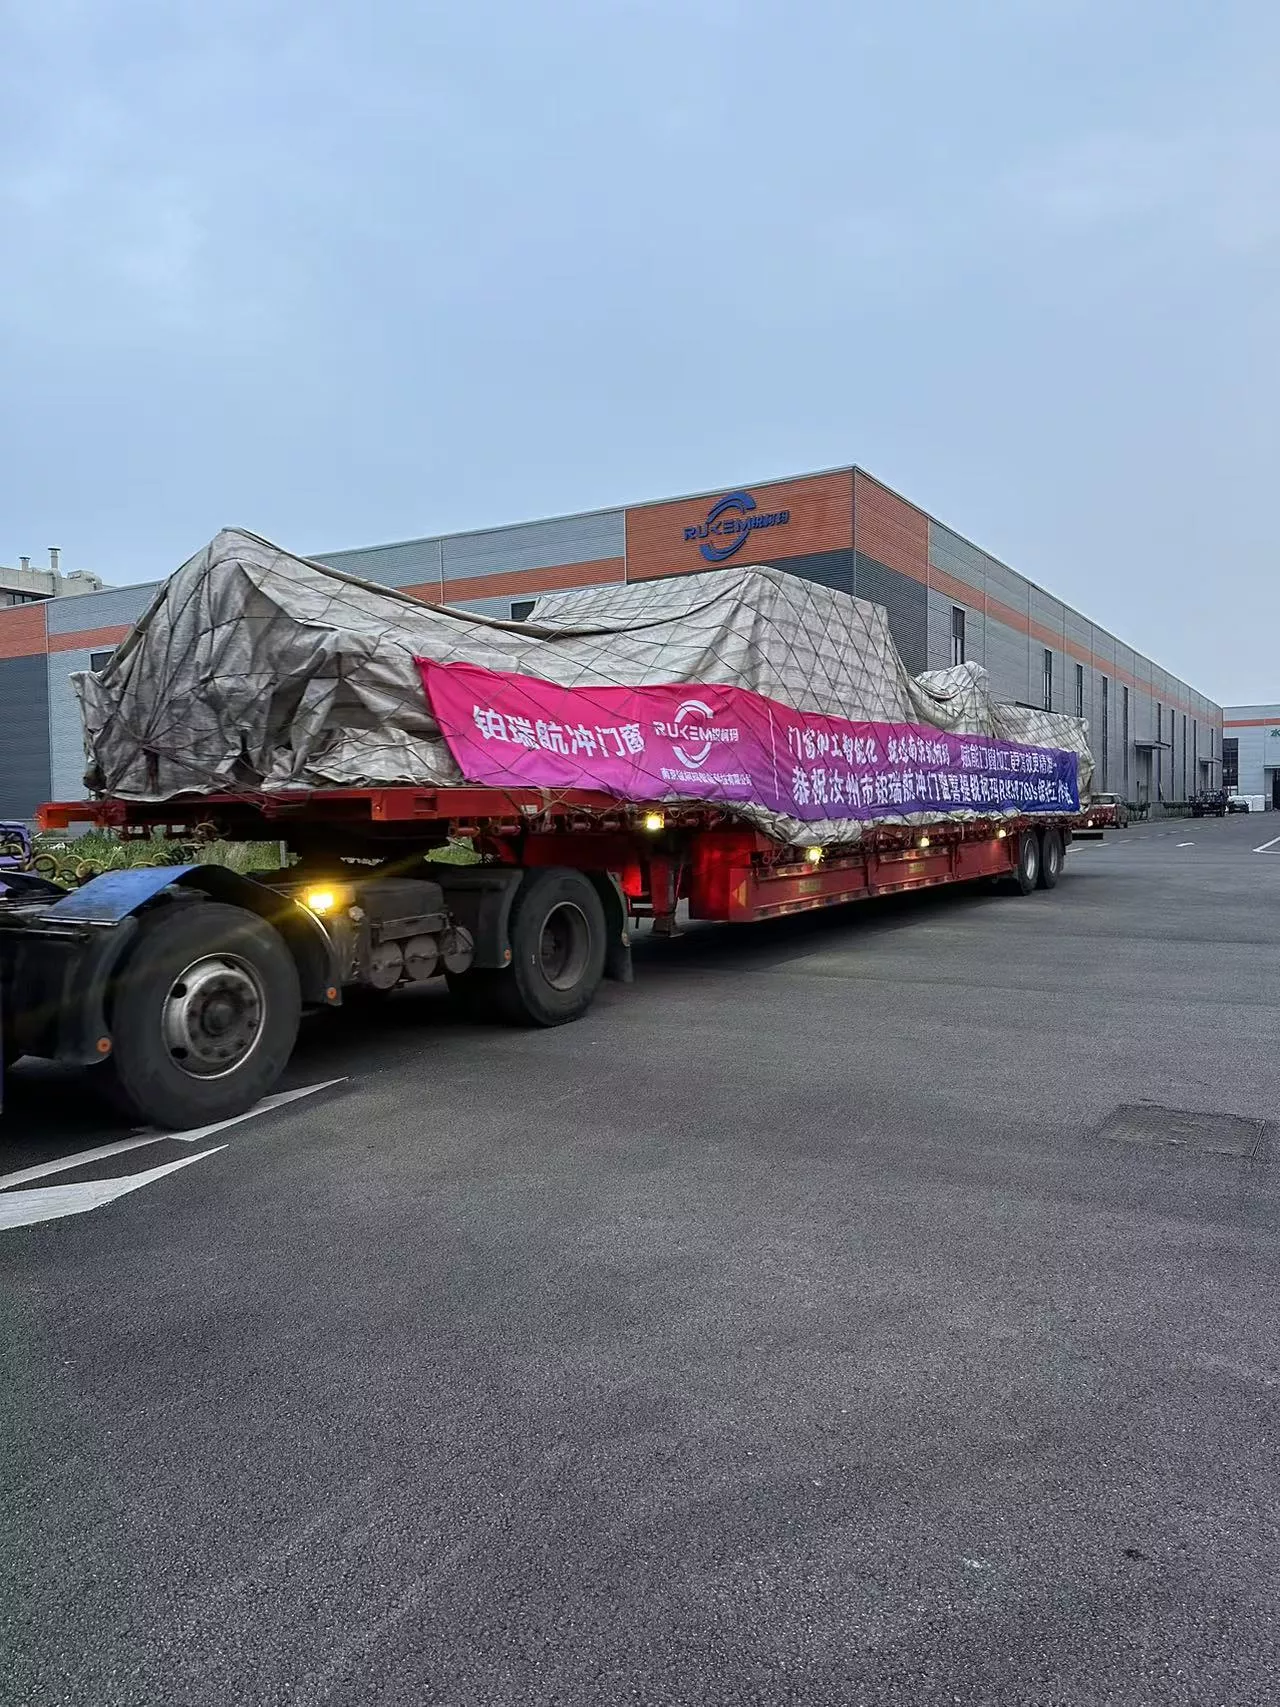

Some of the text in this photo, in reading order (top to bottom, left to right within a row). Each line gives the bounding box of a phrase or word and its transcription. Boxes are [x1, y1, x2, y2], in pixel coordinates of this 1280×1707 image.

[473, 704, 646, 757] 铂瑞航冲门窗
